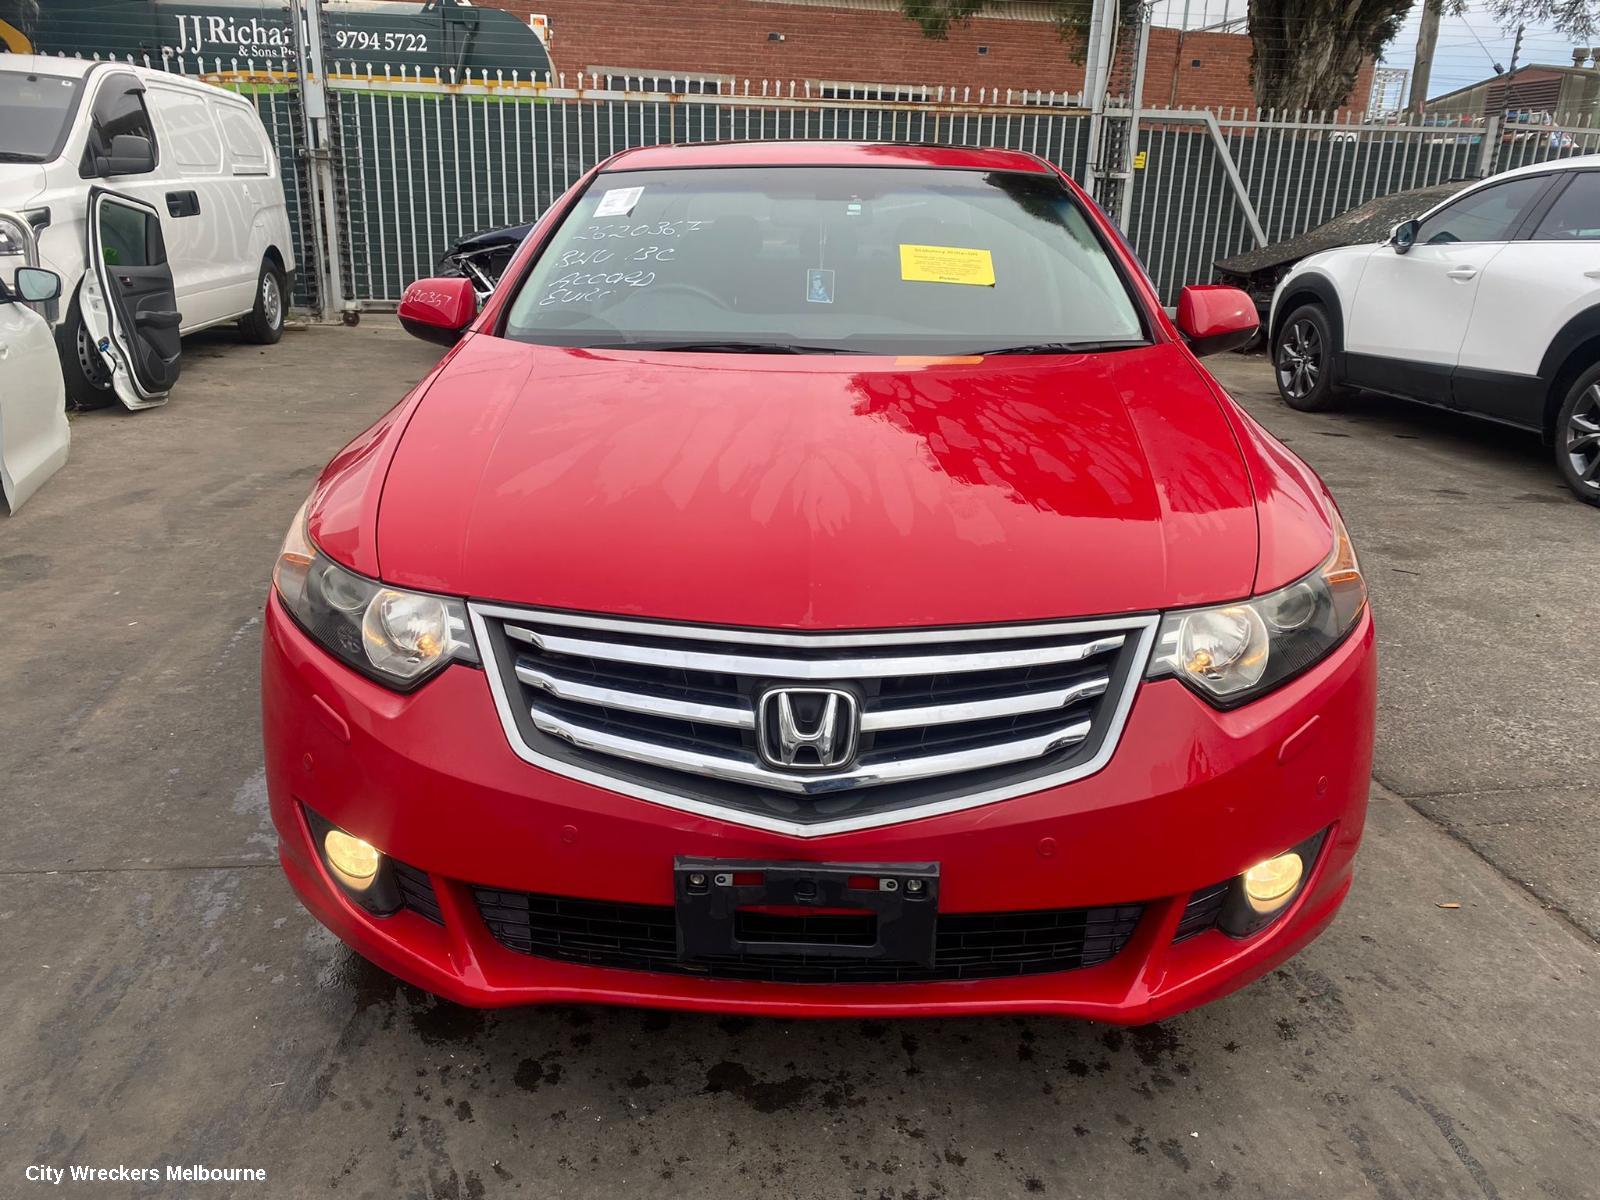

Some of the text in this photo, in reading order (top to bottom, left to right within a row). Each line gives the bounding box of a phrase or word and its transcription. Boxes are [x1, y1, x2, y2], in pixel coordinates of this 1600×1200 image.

[336, 30, 428, 52] 9794 5722
[238, 44, 249, 57] &
[251, 45, 278, 58] Sons
[548, 270, 655, 288] ACCORD
